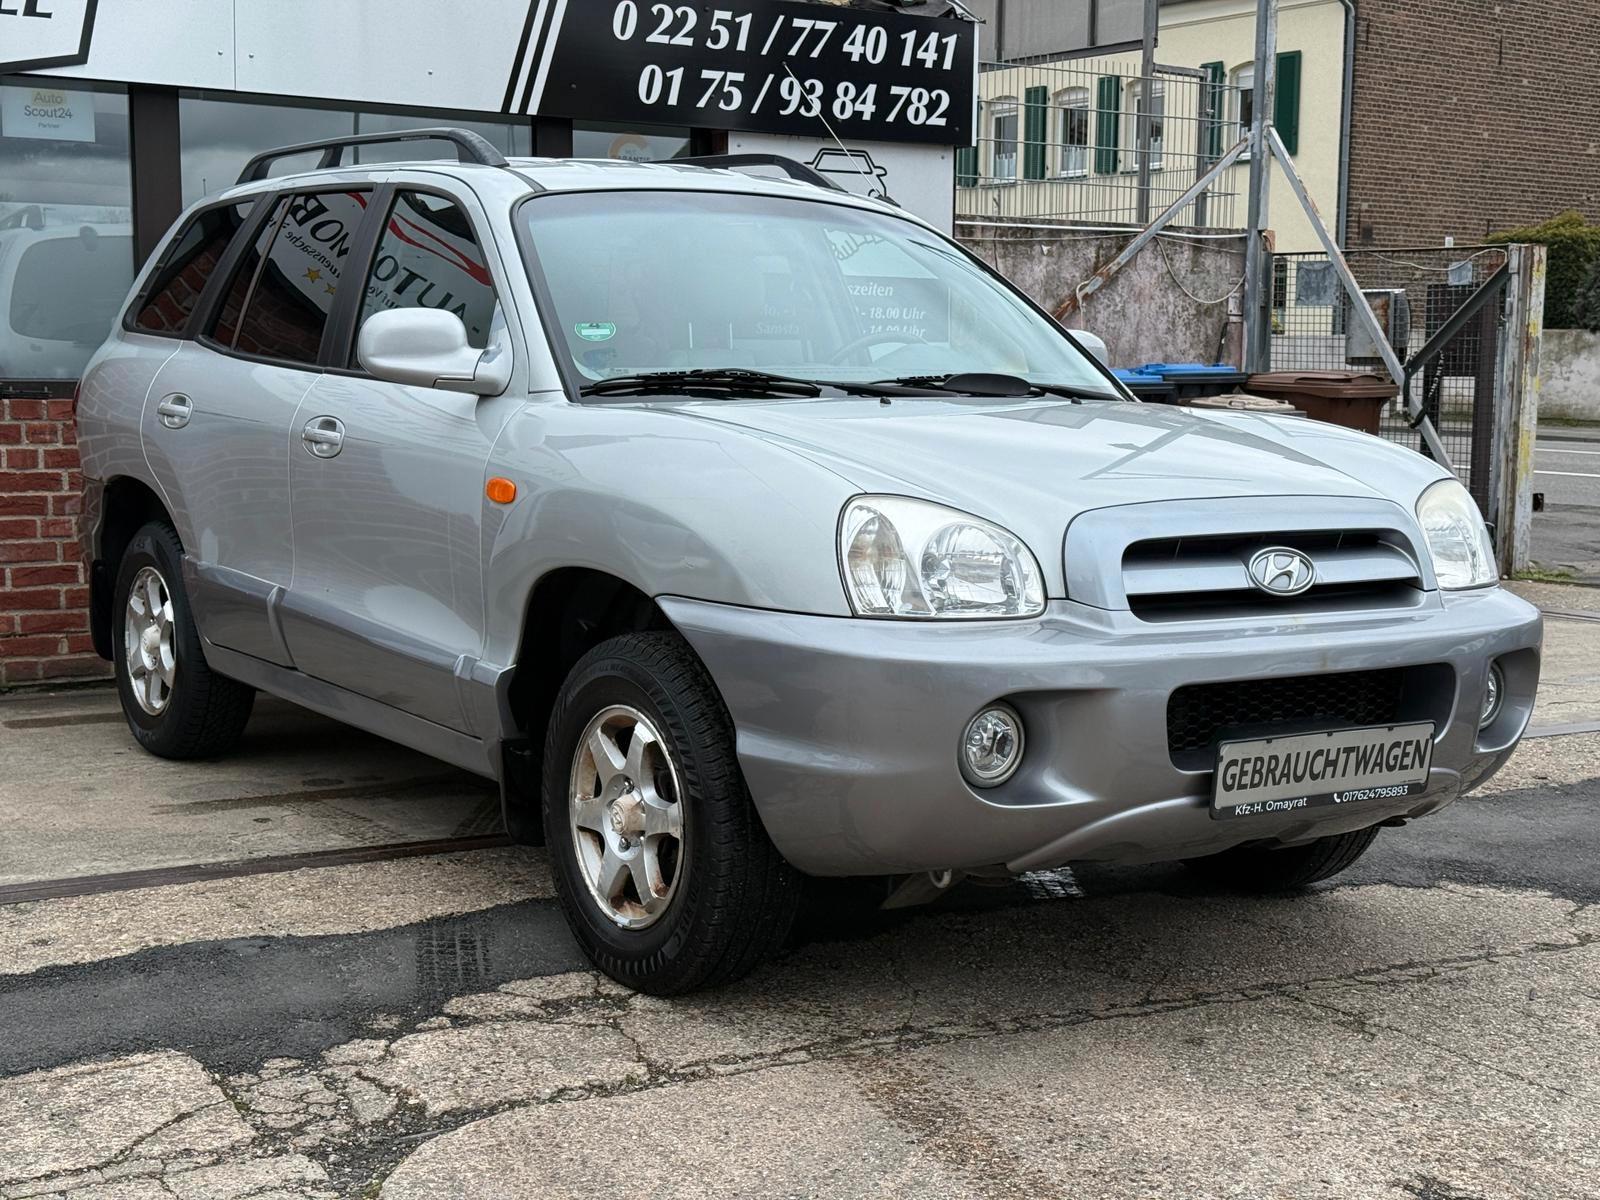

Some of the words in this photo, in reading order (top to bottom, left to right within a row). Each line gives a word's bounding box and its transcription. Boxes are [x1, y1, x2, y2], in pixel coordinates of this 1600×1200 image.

[612, 0, 638, 41] 0
[645, 3, 698, 47] 22
[705, 9, 752, 51] 51
[788, 17, 838, 58] 77
[842, 25, 888, 64] 40
[900, 29, 959, 70] 141
[33, 91, 64, 105] Auto
[638, 64, 685, 105] 01
[696, 69, 745, 111] 75
[779, 76, 824, 117] 93
[832, 81, 878, 121] 84
[885, 86, 950, 126] 782
[24, 104, 73, 119] Scout24
[870, 307, 900, 319] 18.00
[903, 307, 926, 319] Uhr
[1222, 739, 1429, 792] GEBRAUCHTWAGEN
[1235, 802, 1263, 816] Kfz-H.
[1266, 797, 1307, 811] Omayrat
[1343, 786, 1408, 802] 017624795893
